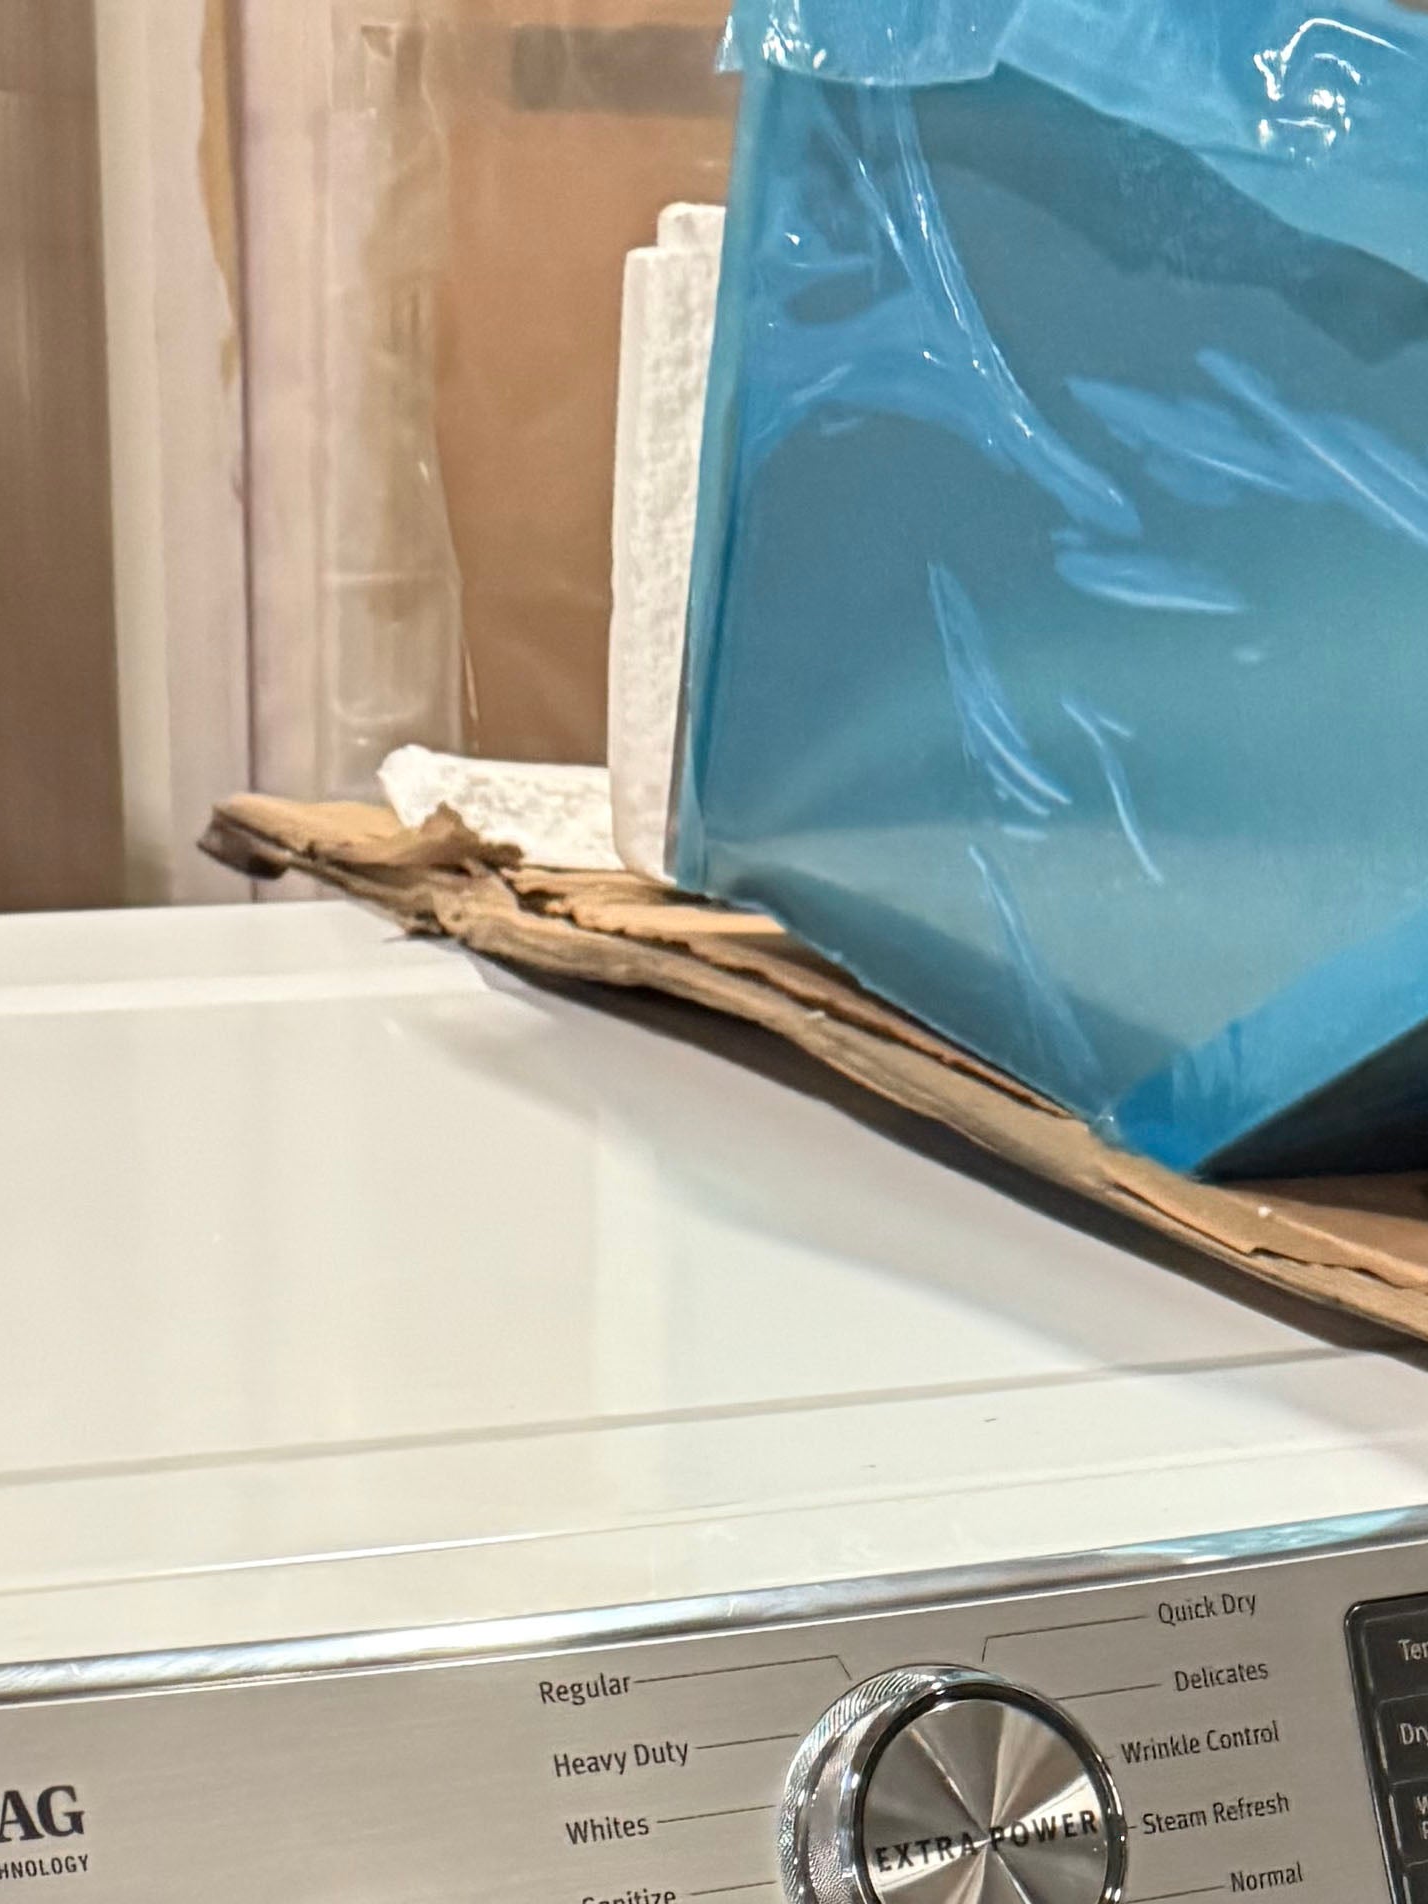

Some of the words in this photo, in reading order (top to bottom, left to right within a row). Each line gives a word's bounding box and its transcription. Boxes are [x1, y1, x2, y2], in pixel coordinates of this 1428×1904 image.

[1158, 1596, 1216, 1626] Quick
[1222, 1593, 1256, 1616] Dry
[539, 1673, 630, 1705] Regular
[1174, 1663, 1269, 1692] Delicates
[1121, 1735, 1201, 1764] Wrinkle
[1206, 1720, 1279, 1751] Control
[553, 1751, 626, 1777] Heavy
[633, 1741, 688, 1767] Duty
[1142, 1808, 1207, 1835] Steam
[1213, 1792, 1290, 1824] Refresh
[566, 1816, 649, 1845] Whites
[874, 1831, 979, 1873] EXTRA
[989, 1810, 1098, 1851] POWER
[1230, 1861, 1303, 1892] Normal
